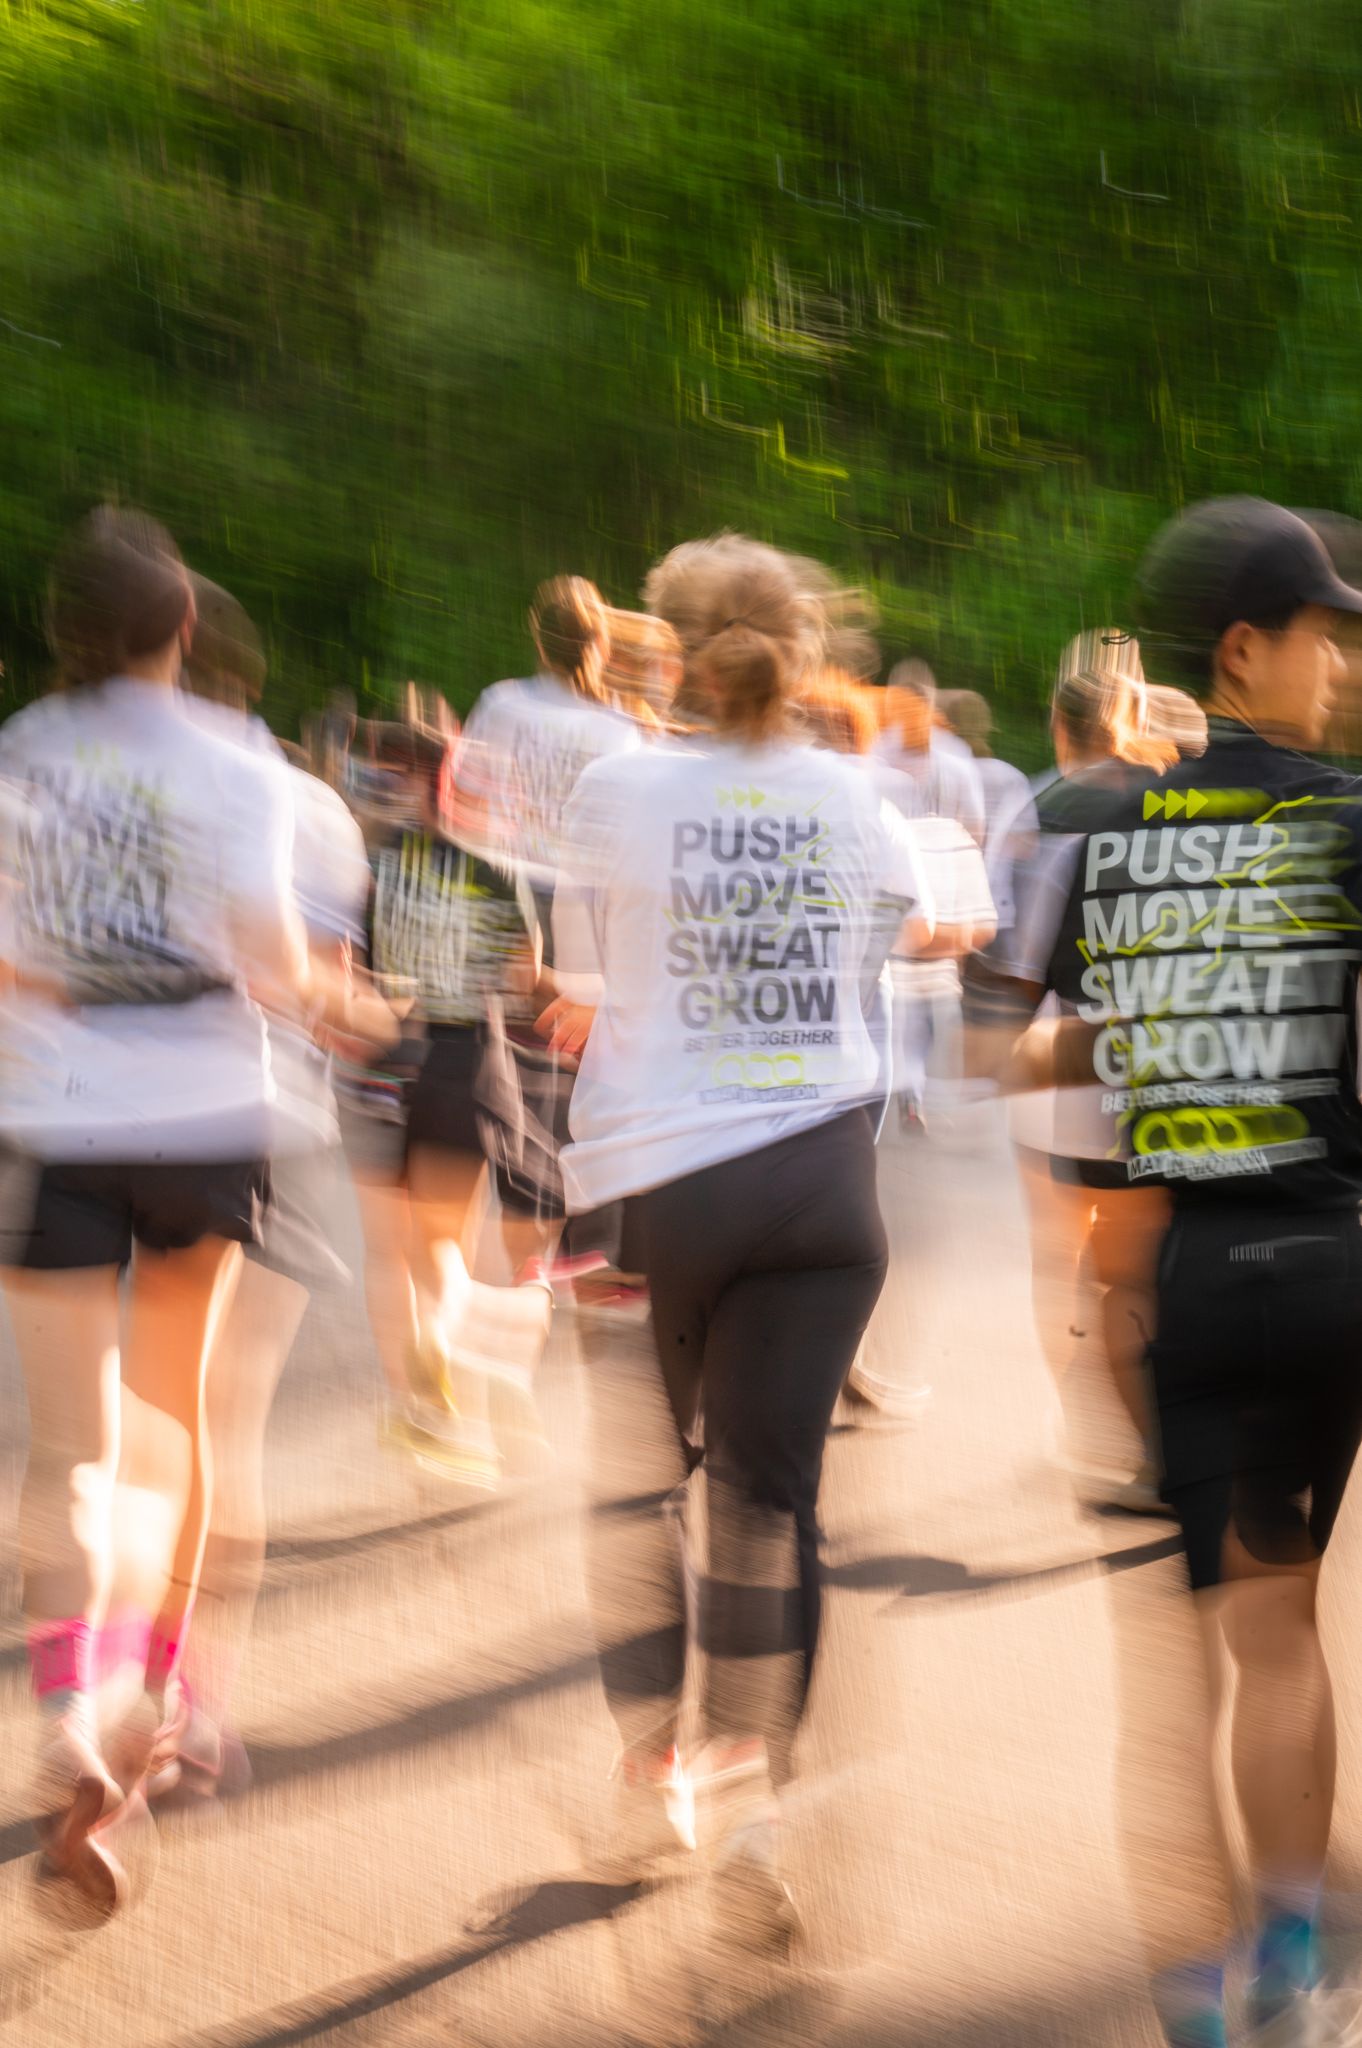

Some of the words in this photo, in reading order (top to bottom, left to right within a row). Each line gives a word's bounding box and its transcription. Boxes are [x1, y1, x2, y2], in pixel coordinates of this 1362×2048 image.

[673, 816, 819, 868] PUSH
[1085, 824, 1274, 892] PUSH
[669, 868, 828, 922] MOVE
[1082, 888, 1282, 957] MOVE
[666, 922, 841, 977] SWEAT
[679, 975, 836, 1030] GROW
[1077, 954, 1302, 1024] SWEAT
[1093, 1020, 1289, 1088] GROW
